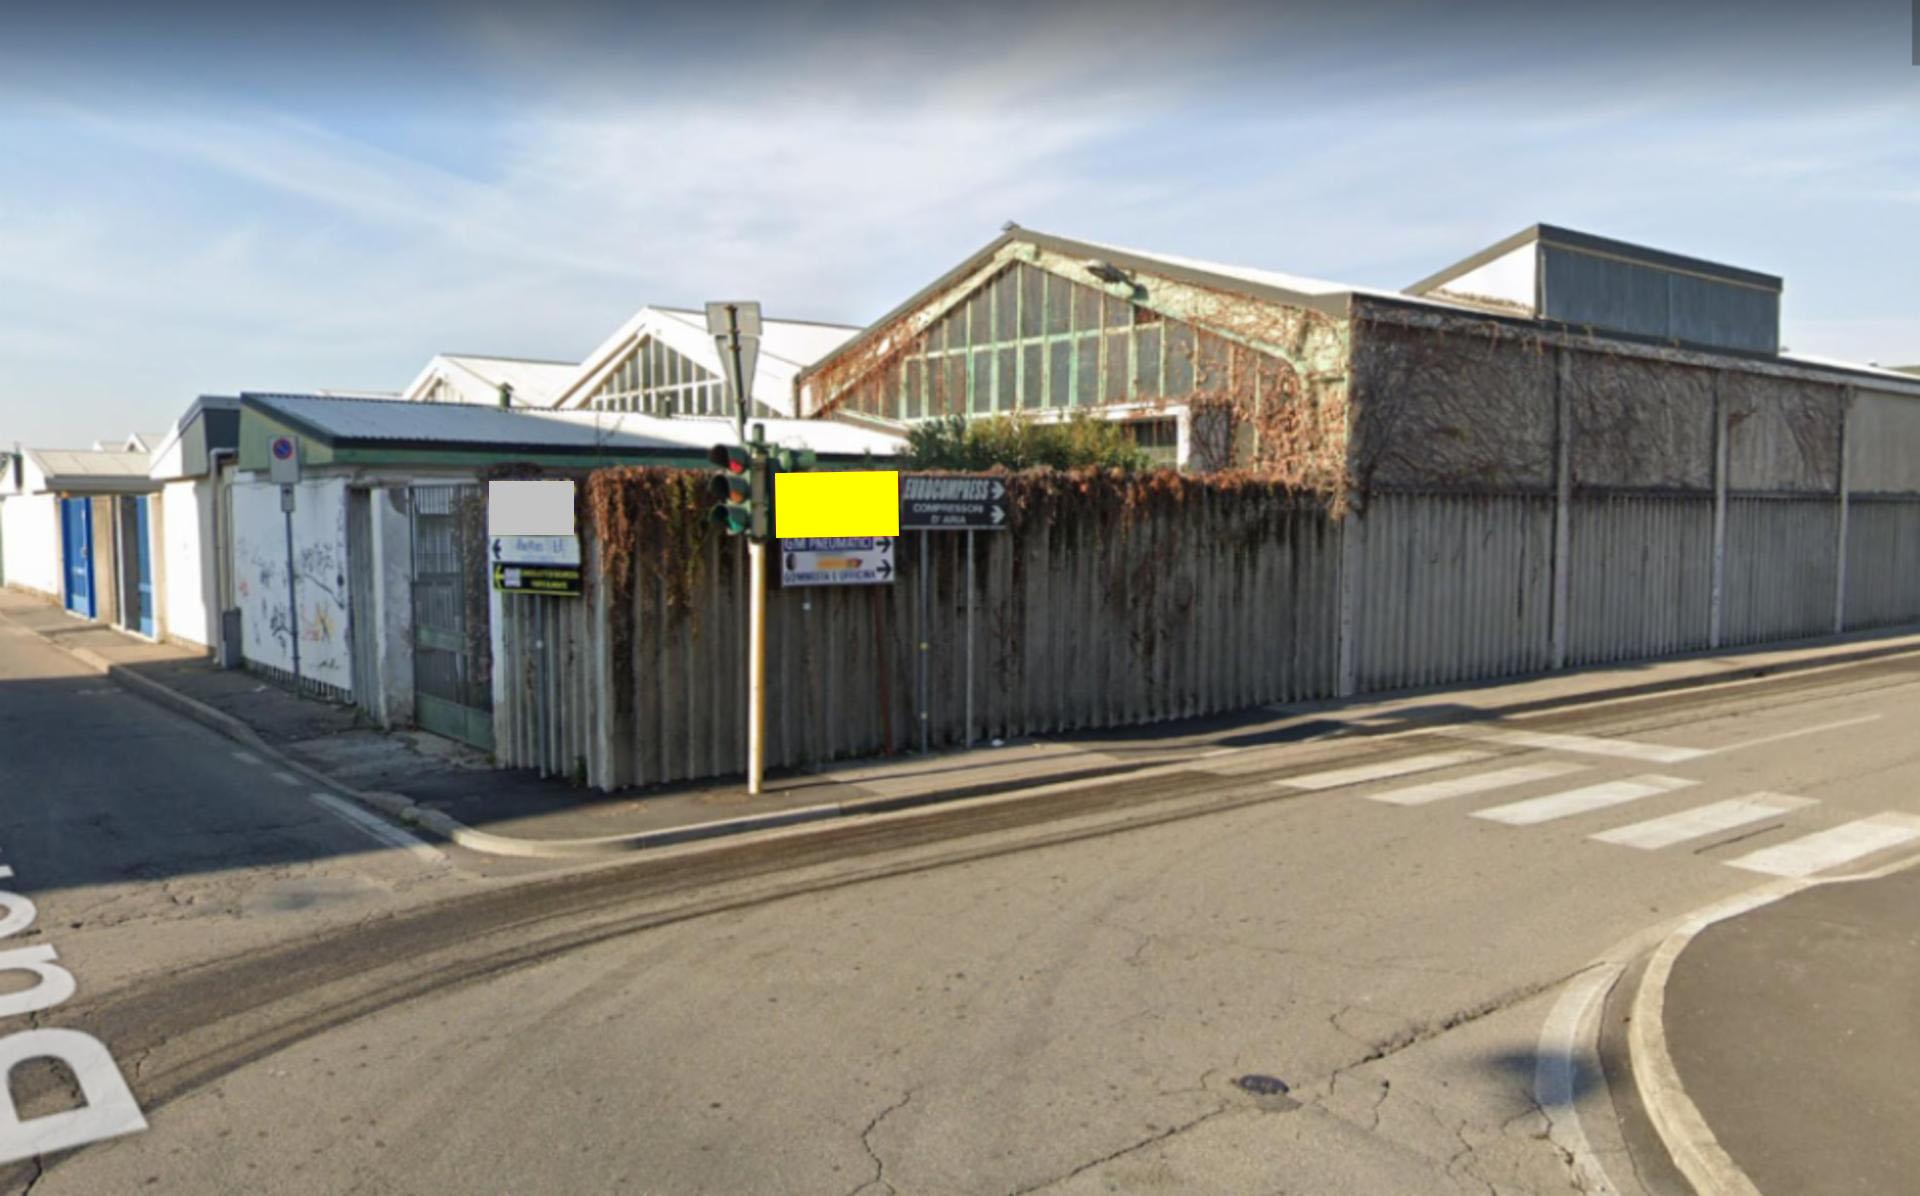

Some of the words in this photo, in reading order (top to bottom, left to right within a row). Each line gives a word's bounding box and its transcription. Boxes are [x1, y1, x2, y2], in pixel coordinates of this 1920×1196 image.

[904, 478, 989, 500] EUROCOMPRESS
[913, 503, 984, 513] COMPRESSORI
[943, 514, 967, 524] ARIA
